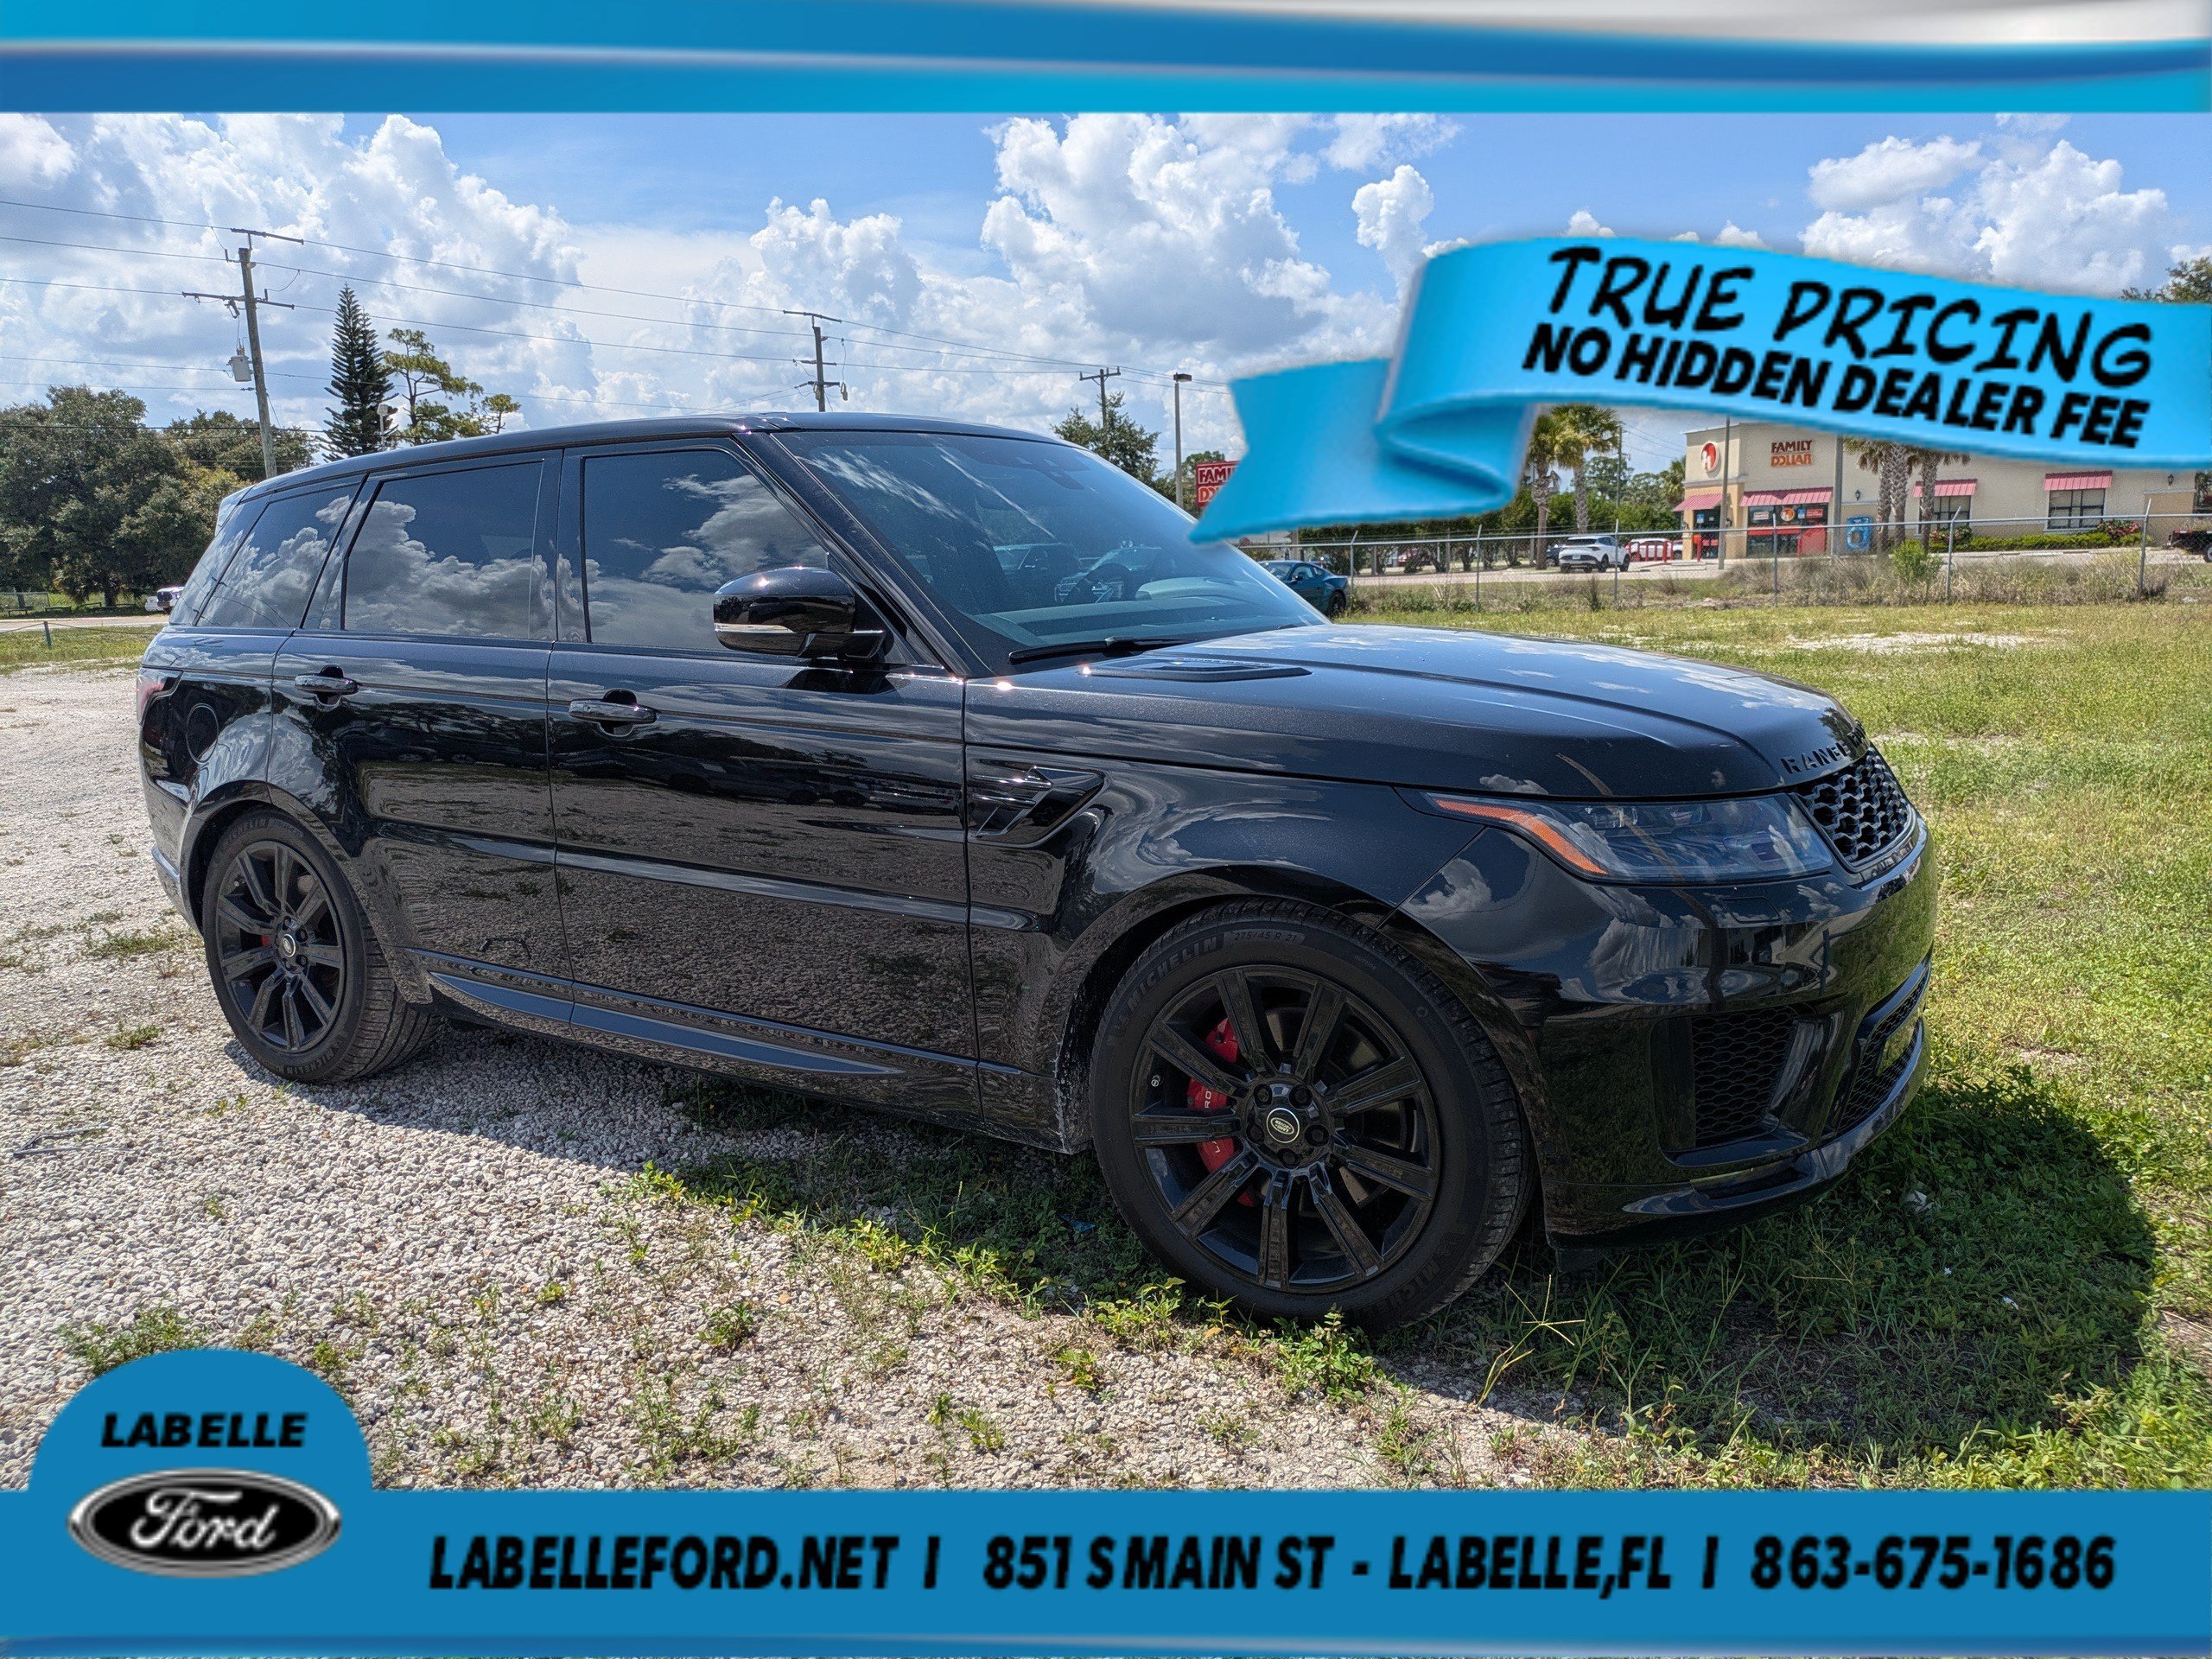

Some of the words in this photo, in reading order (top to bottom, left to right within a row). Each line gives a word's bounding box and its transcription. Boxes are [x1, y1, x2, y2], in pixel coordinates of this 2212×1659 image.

[1770, 440, 1813, 453] FAMILY
[1770, 453, 1813, 467] DOLLAR
[1127, 935, 1219, 1013] MICHELIN
